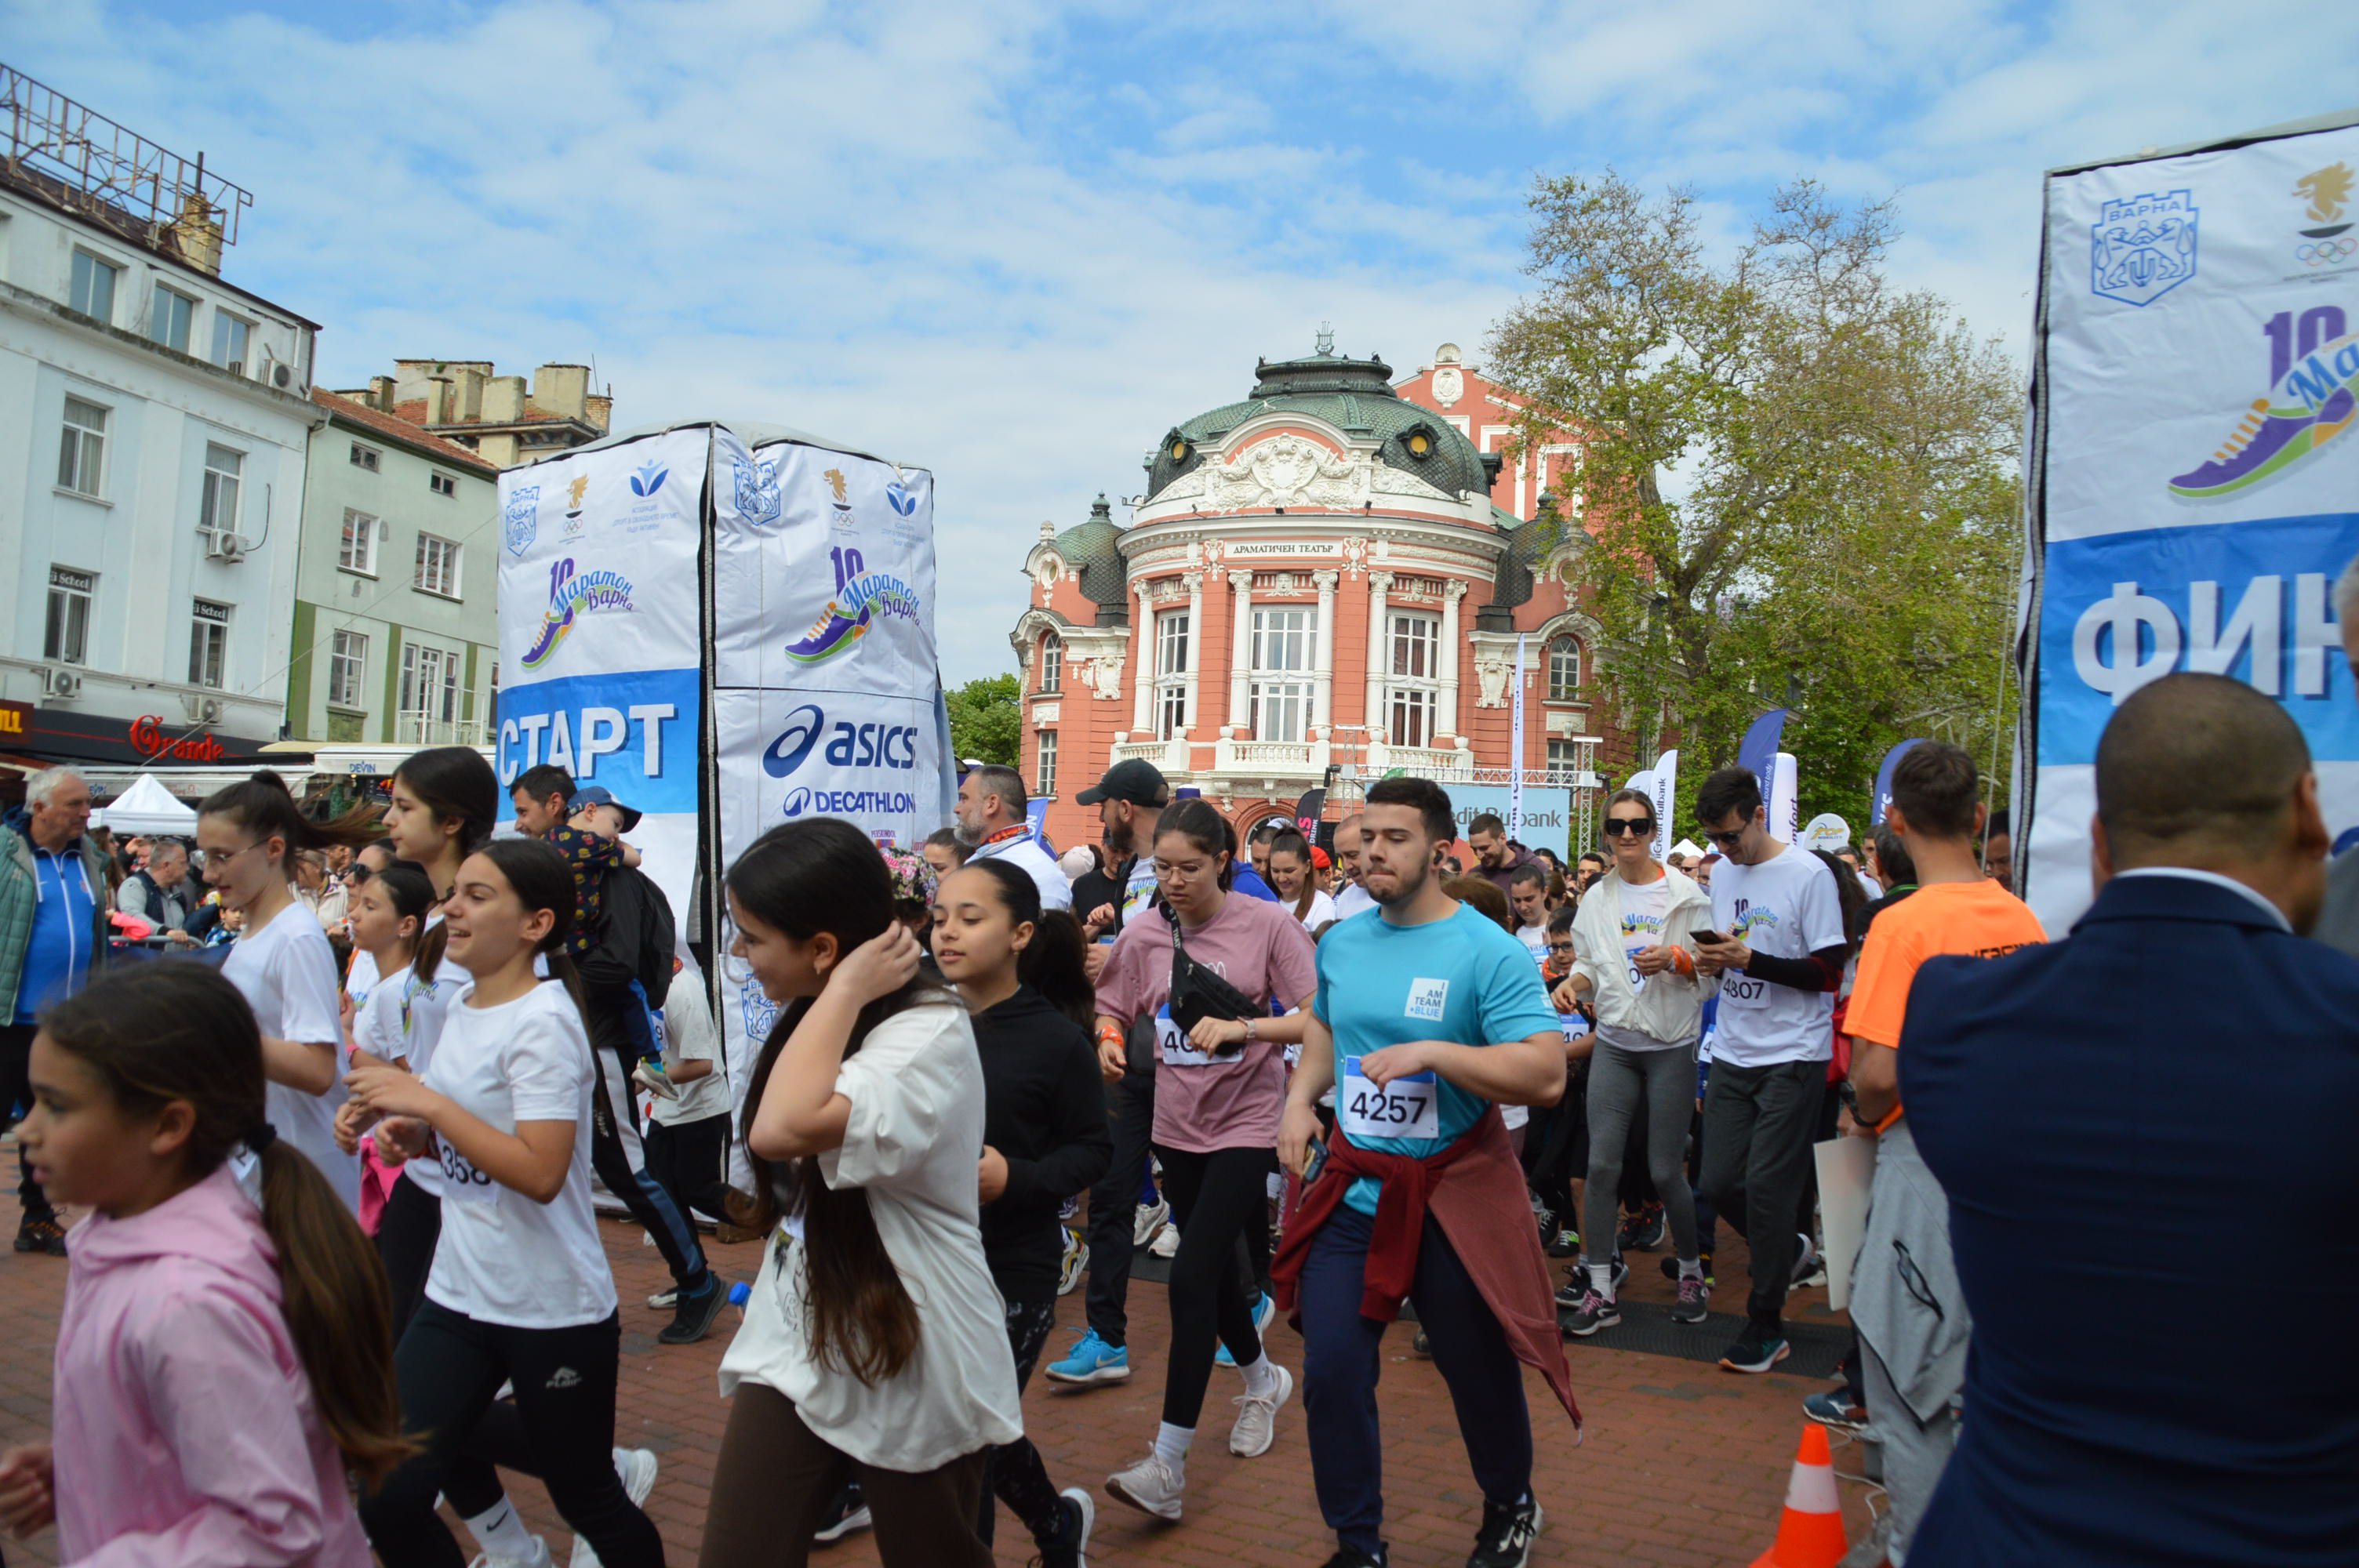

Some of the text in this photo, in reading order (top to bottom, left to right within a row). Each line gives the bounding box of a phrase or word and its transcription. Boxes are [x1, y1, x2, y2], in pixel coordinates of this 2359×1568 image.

[2108, 201, 2182, 223] ВАРНА
[510, 493, 535, 505] ВАРНА
[1233, 544, 1333, 554] ДРАМАТИЧЕН ТЕАТЪР
[59, 572, 89, 589] School
[550, 557, 574, 606] 10
[830, 545, 865, 598] 10
[554, 570, 633, 616] Маратон
[587, 587, 634, 612] Варна
[843, 574, 921, 617] Маратон
[878, 591, 921, 626] Варна
[129, 714, 224, 762] Grande
[499, 703, 678, 789] СТАРТ
[349, 761, 376, 773] DEVIN
[815, 791, 916, 814] DECATHLON
[1656, 778, 1667, 820] Bulbank
[1415, 996, 1441, 1007] TEAM
[1427, 989, 1443, 999] AM
[1722, 978, 1765, 1000] 4807
[1350, 1091, 1427, 1124] 4257
